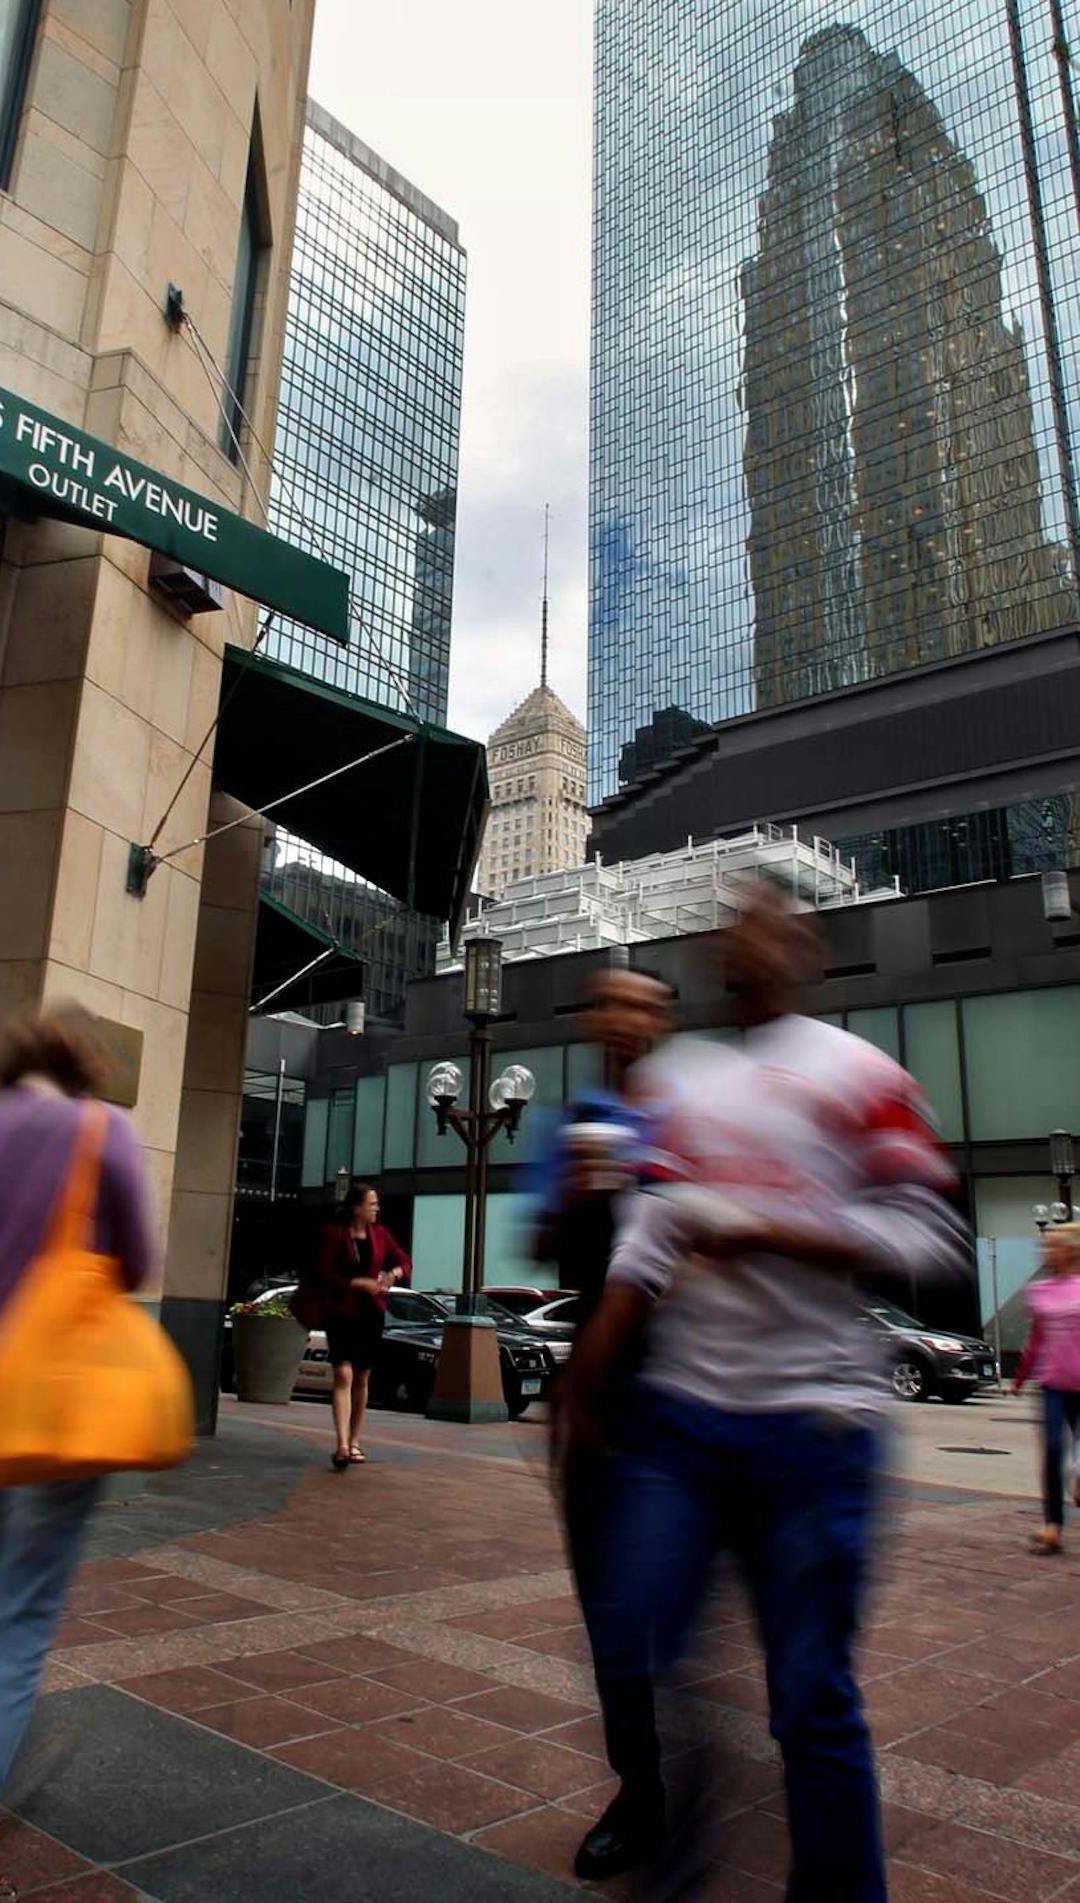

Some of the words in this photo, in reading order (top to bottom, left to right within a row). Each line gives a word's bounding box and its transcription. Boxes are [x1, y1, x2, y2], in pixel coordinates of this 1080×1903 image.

[16, 413, 95, 478] FIFTH
[104, 465, 220, 542] AVENUE
[28, 463, 119, 523] OUTLET
[492, 736, 541, 764] FOSHAY
[560, 738, 586, 763] FOSH
